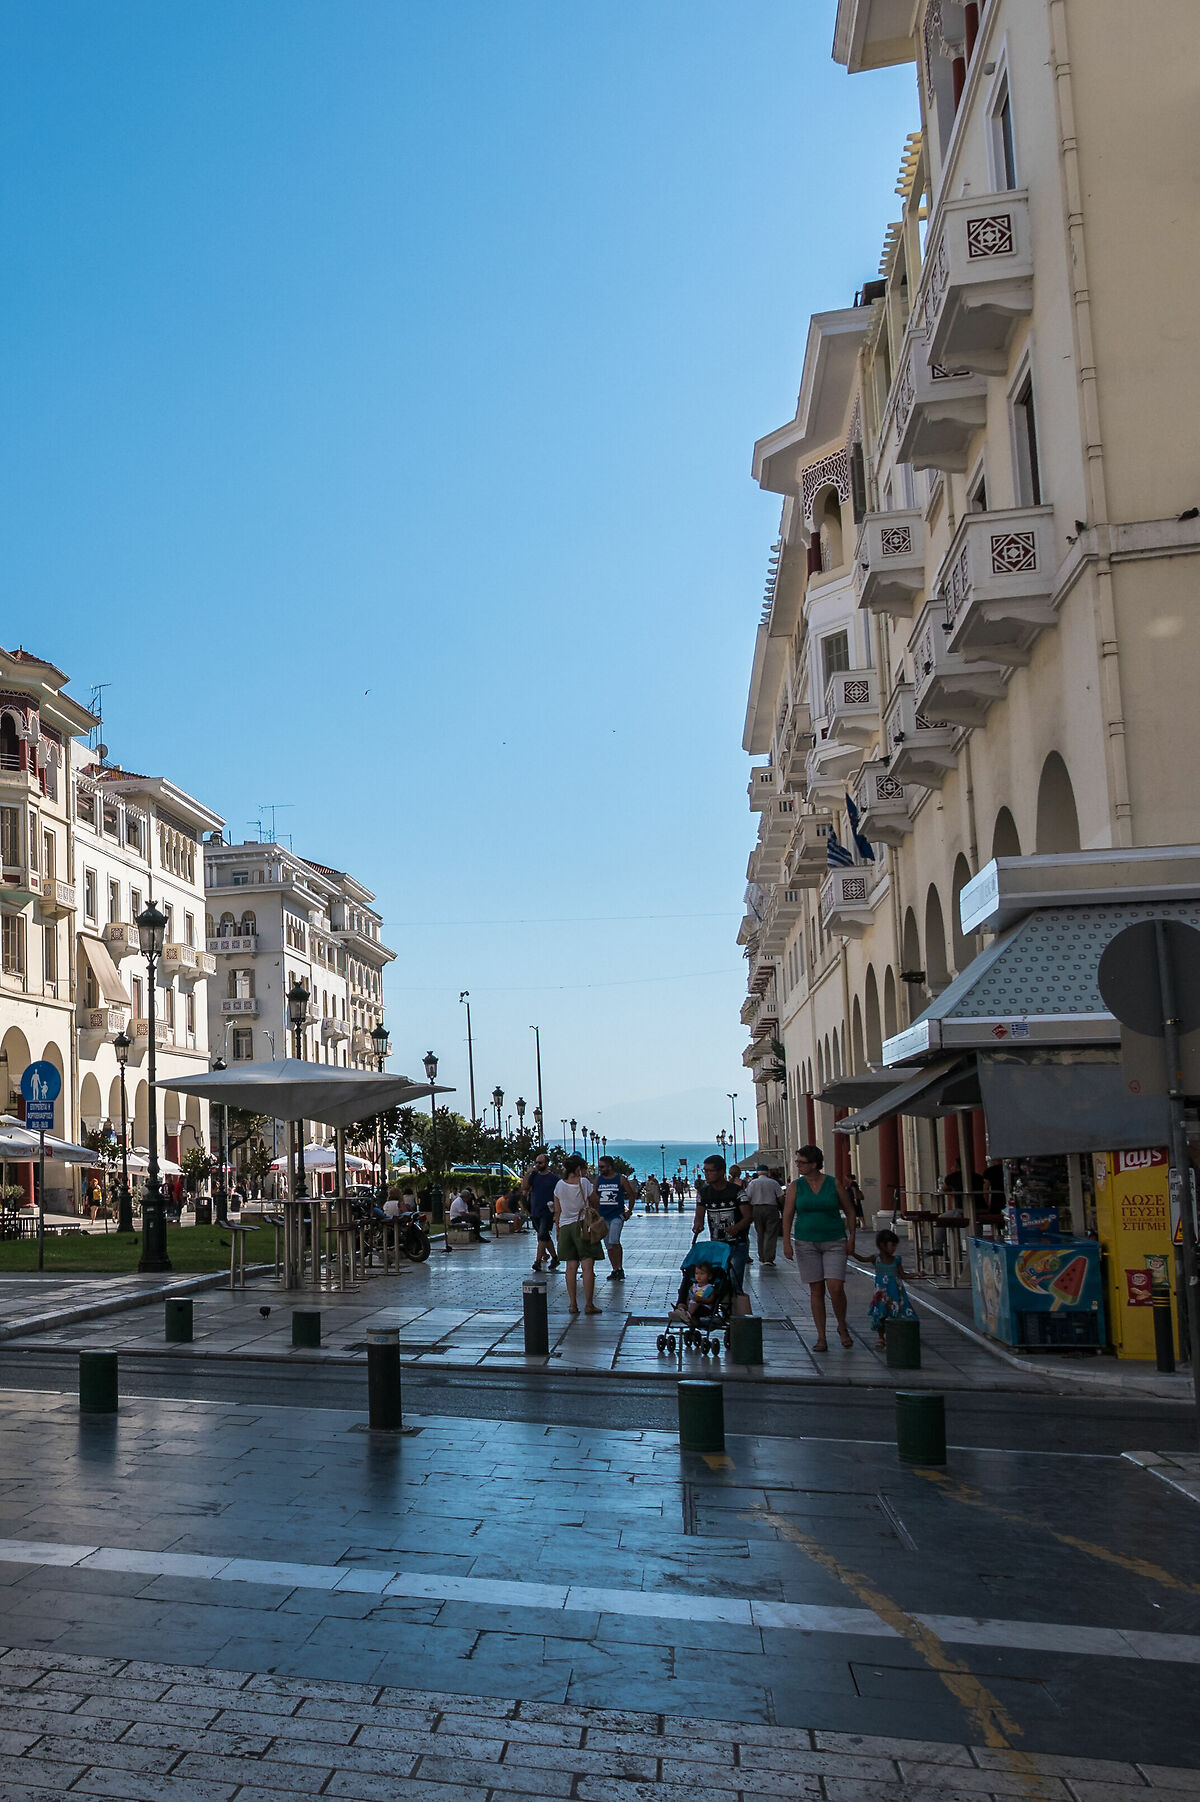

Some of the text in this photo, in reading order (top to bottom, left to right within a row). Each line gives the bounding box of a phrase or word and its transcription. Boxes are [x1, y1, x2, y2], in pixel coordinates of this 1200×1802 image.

[1121, 1194, 1165, 1206] ΔΩΣΕ
[1121, 1207, 1166, 1217] ΓΕΥΣΗ
[1123, 1222, 1167, 1231] ΣΤΙΓΜΗ
